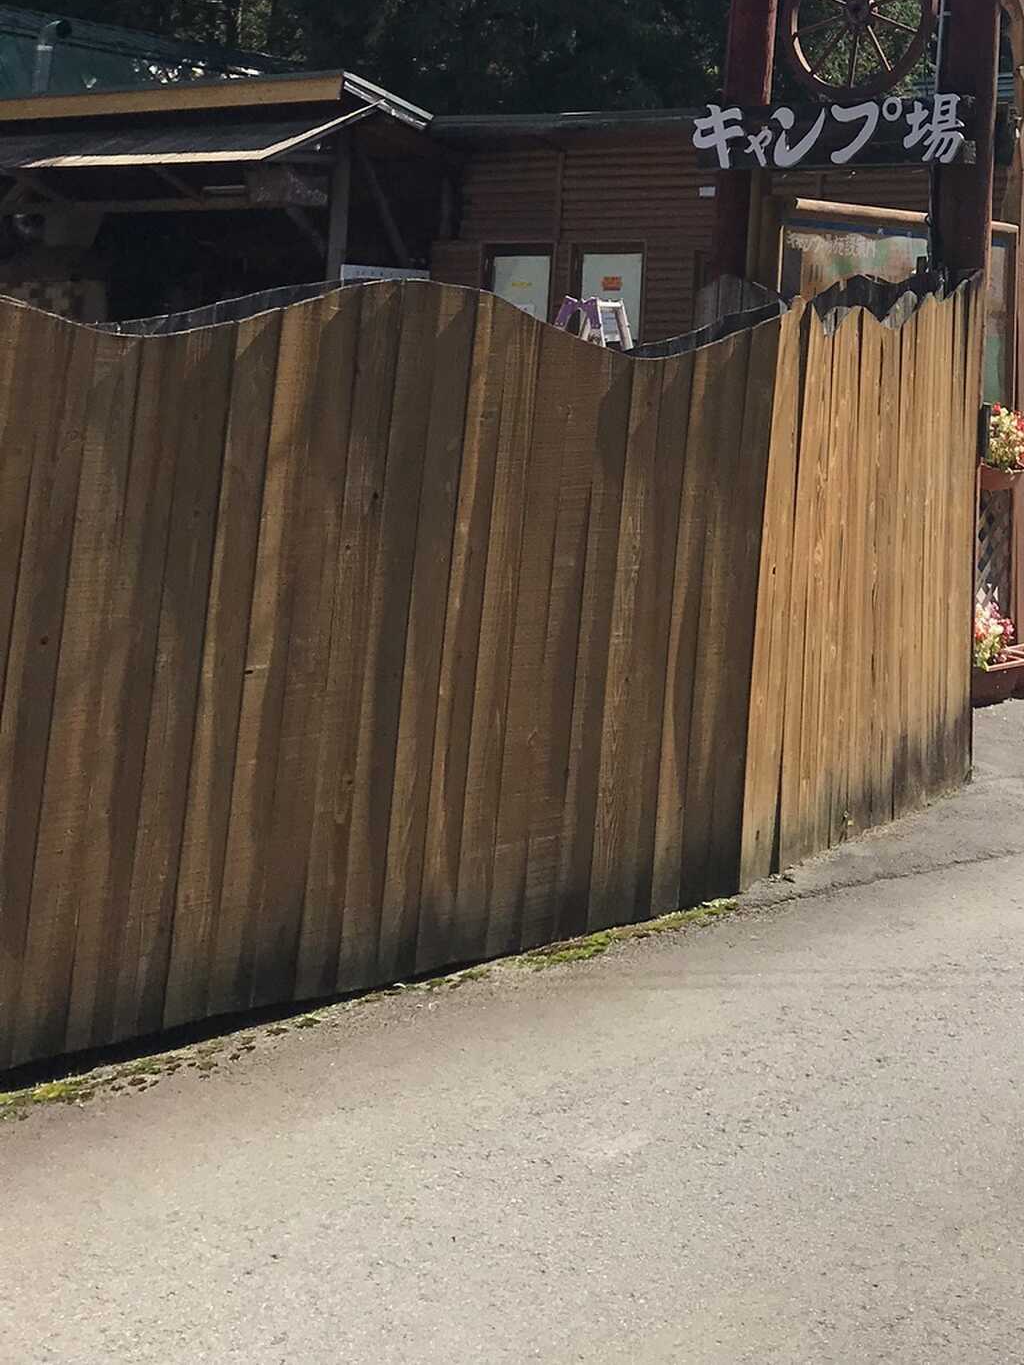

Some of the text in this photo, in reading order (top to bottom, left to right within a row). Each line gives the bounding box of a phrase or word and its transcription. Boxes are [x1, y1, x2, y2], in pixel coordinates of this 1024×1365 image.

[692, 92, 966, 170] キャンプ場
